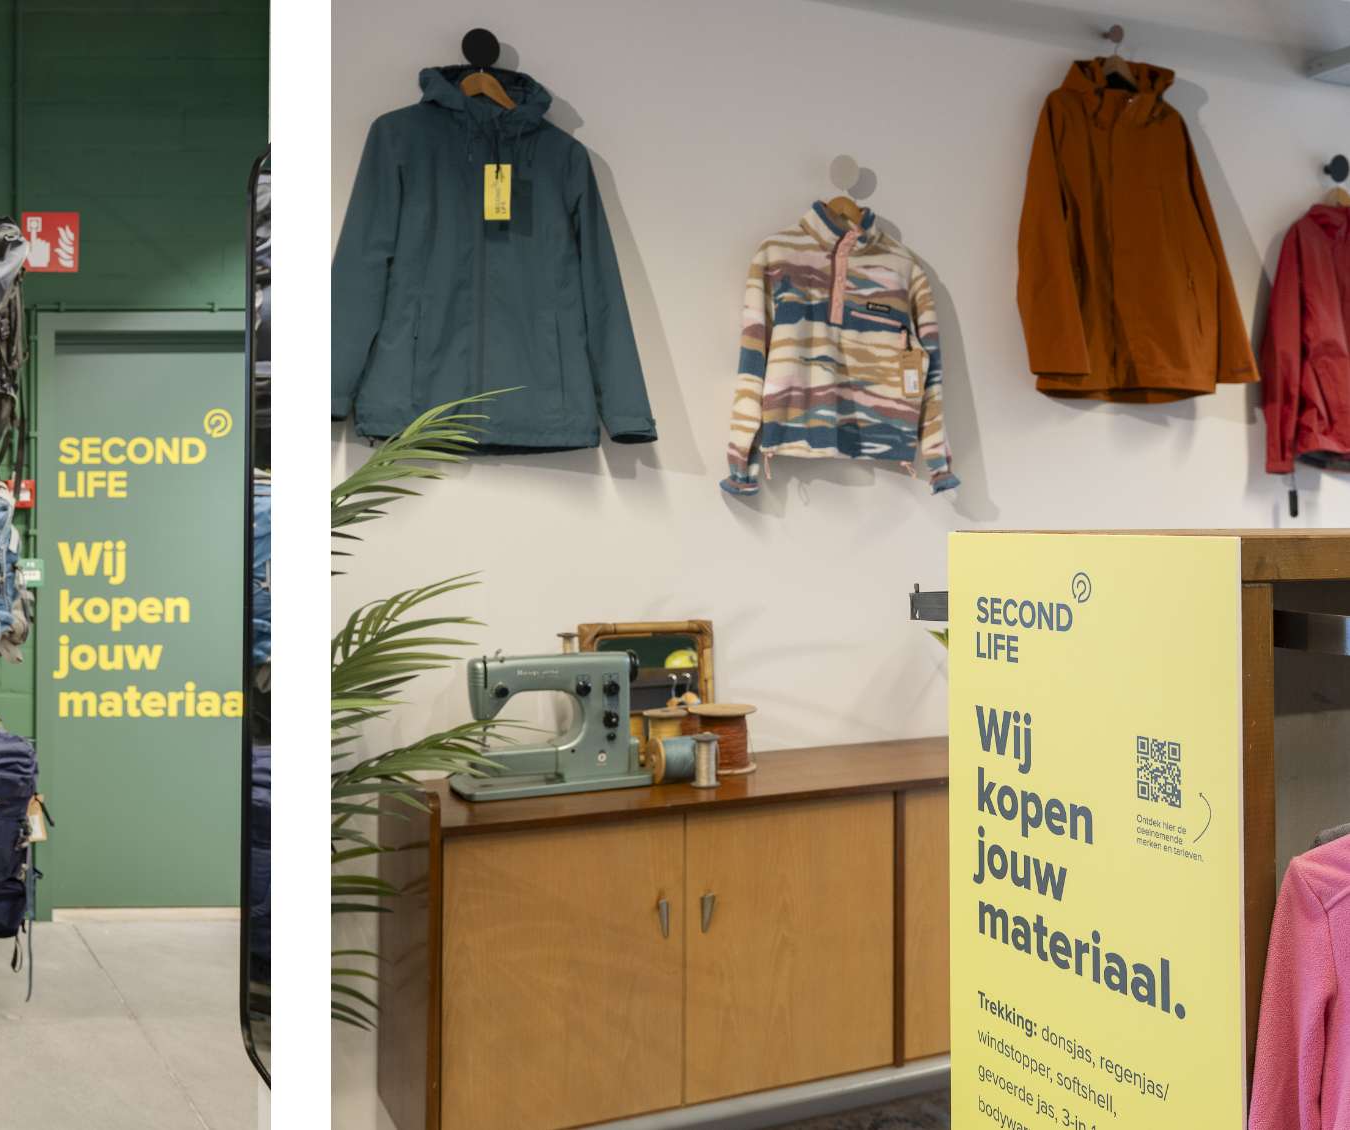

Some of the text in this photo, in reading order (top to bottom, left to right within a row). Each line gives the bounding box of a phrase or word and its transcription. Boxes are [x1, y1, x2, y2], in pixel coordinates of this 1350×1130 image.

[58, 436, 207, 465] SECOND
[57, 470, 128, 498] LIFE
[57, 540, 126, 585] Wij
[59, 588, 190, 632] kopen
[976, 596, 1074, 632] SECOND
[53, 634, 163, 679] jouw
[976, 631, 1019, 664] LIFE
[975, 704, 1032, 775] Wij
[977, 767, 1093, 845] kopen
[1136, 814, 1187, 835] Ontdek hier de
[972, 825, 1068, 902] jouw
[1136, 837, 1162, 850] merken
[1163, 844, 1173, 853] en
[978, 900, 1187, 1019] materiaal.
[977, 990, 1170, 1102] Trekking: donsjas, regenjas/
[977, 1029, 1118, 1118] windstopper, softshell,
[977, 1064, 1035, 1106] gevoerde
[1036, 1093, 1059, 1124] jas,
